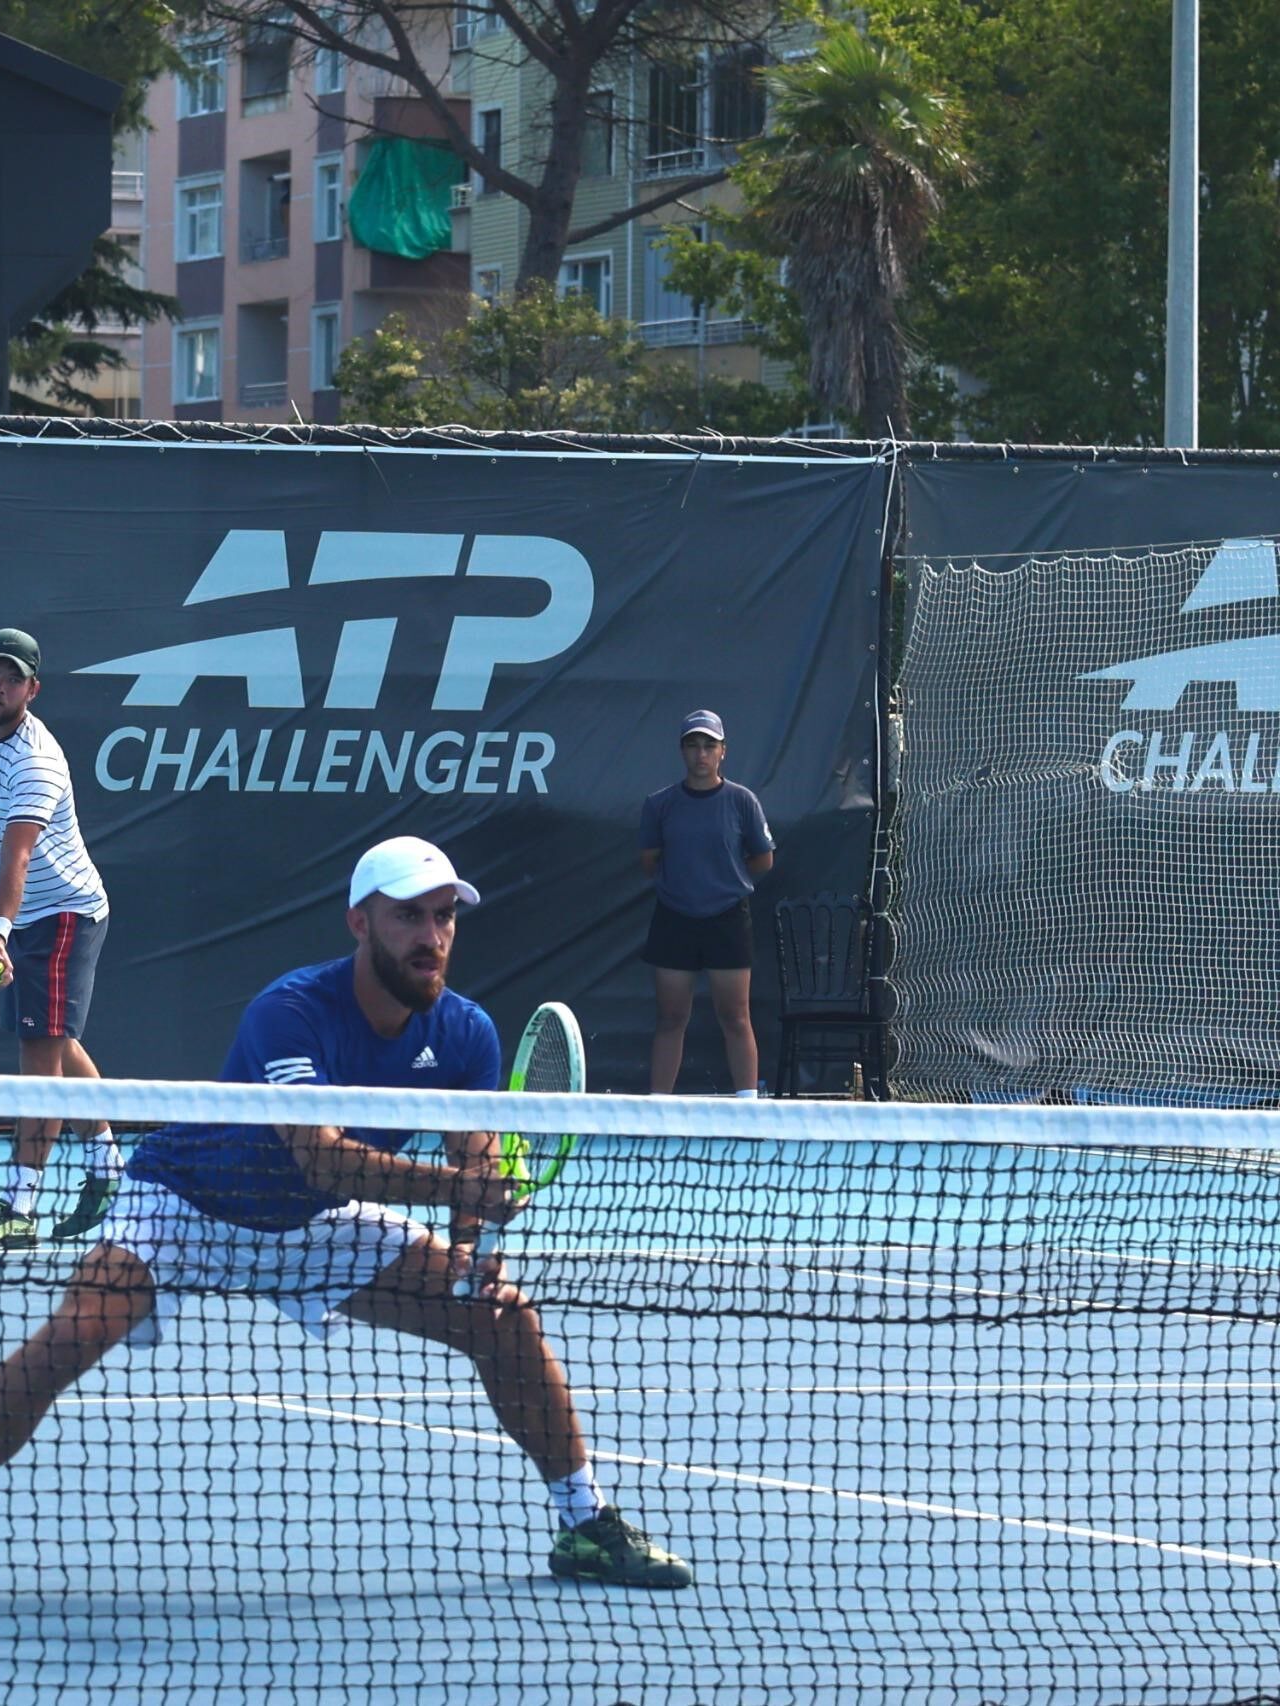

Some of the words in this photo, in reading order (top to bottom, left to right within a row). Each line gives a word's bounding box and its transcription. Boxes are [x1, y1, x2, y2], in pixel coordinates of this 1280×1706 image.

[69, 529, 594, 711] ATP
[95, 726, 556, 794] CHALLENGER
[1100, 730, 1280, 793] CHAL
